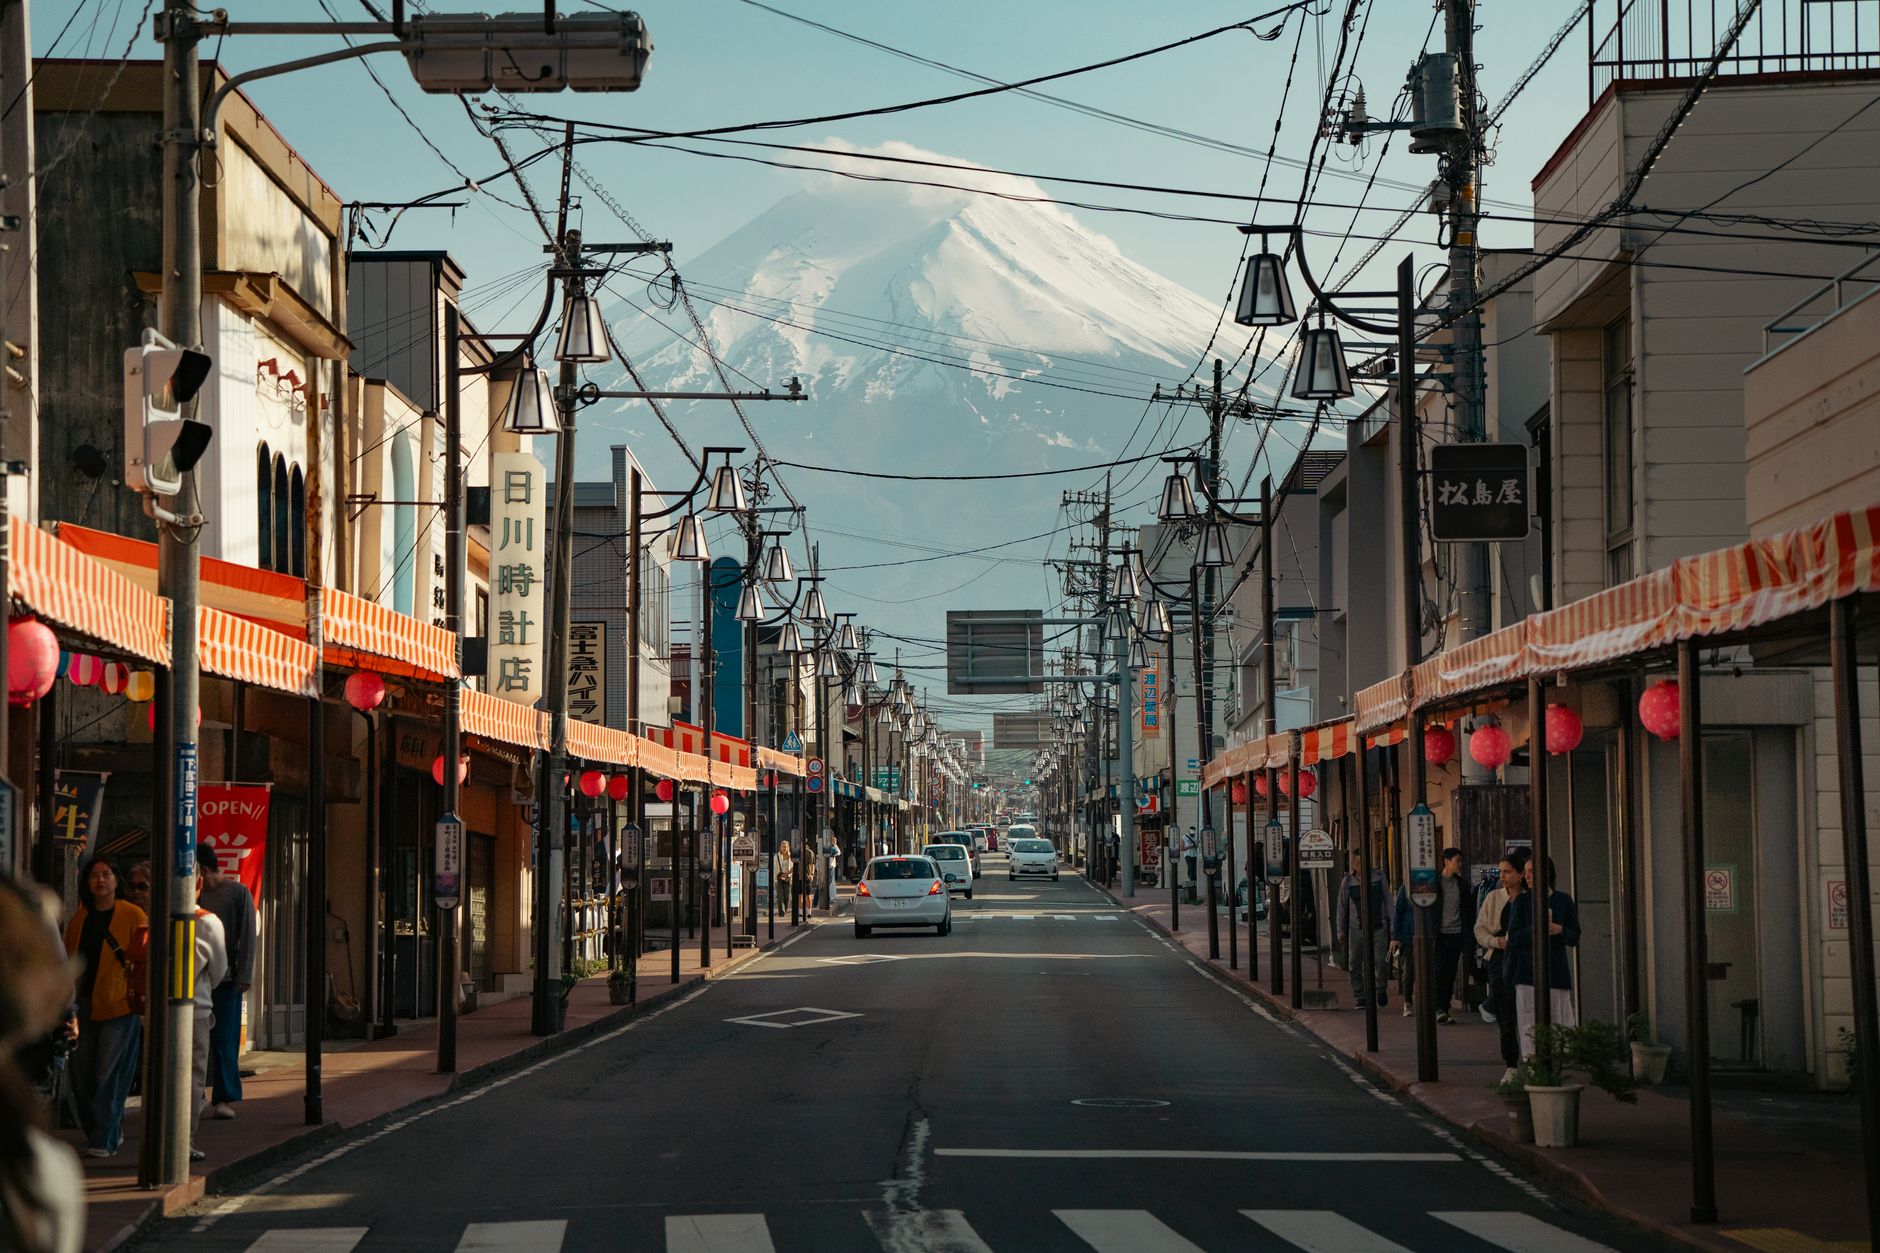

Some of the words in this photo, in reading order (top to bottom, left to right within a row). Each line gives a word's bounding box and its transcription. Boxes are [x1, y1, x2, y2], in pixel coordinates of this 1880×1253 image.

[1438, 478, 1522, 506] 松島屋
[497, 470, 535, 692] 日川時計店
[1144, 673, 1157, 726] 渡辺薬局
[202, 800, 253, 816] OPEN
